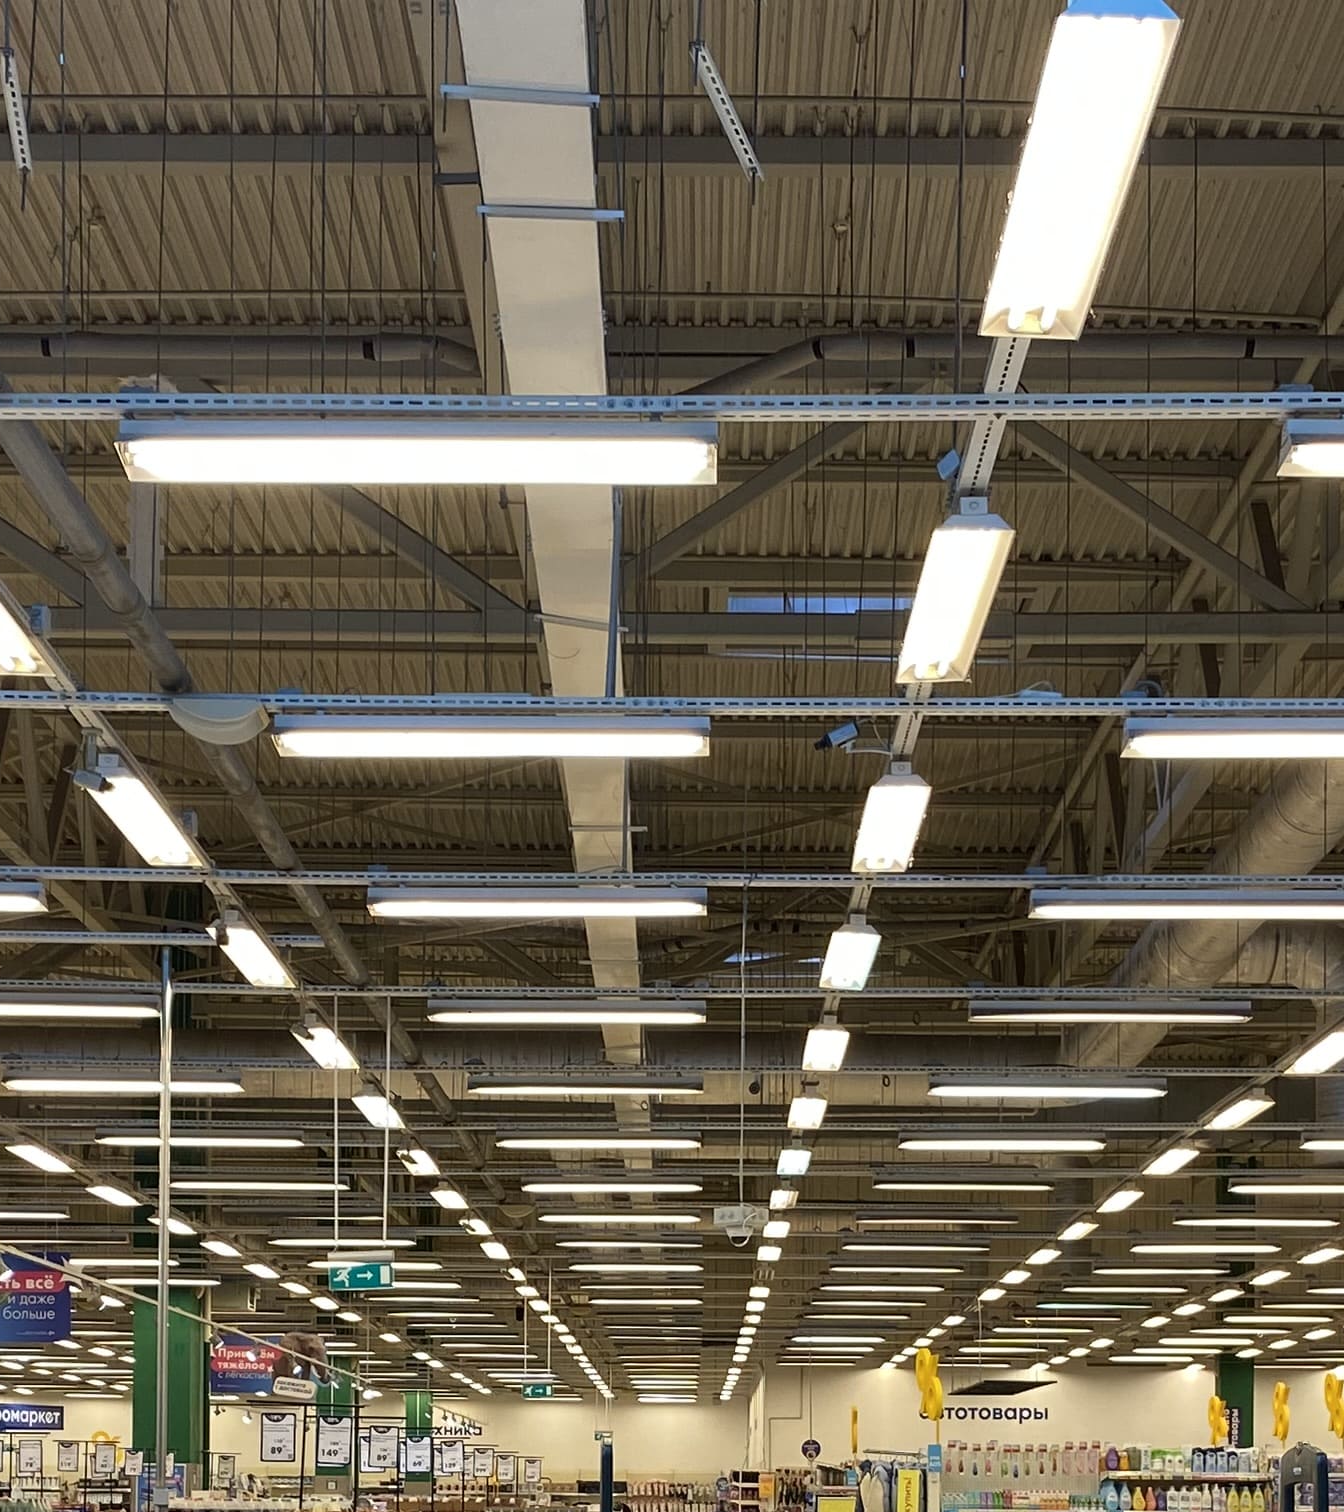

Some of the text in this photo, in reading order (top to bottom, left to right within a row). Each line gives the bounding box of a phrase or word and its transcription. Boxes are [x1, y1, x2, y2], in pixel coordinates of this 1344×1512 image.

[25, 1275, 55, 1289] всё
[19, 1295, 55, 1305] даже
[3, 1308, 55, 1320] больше
